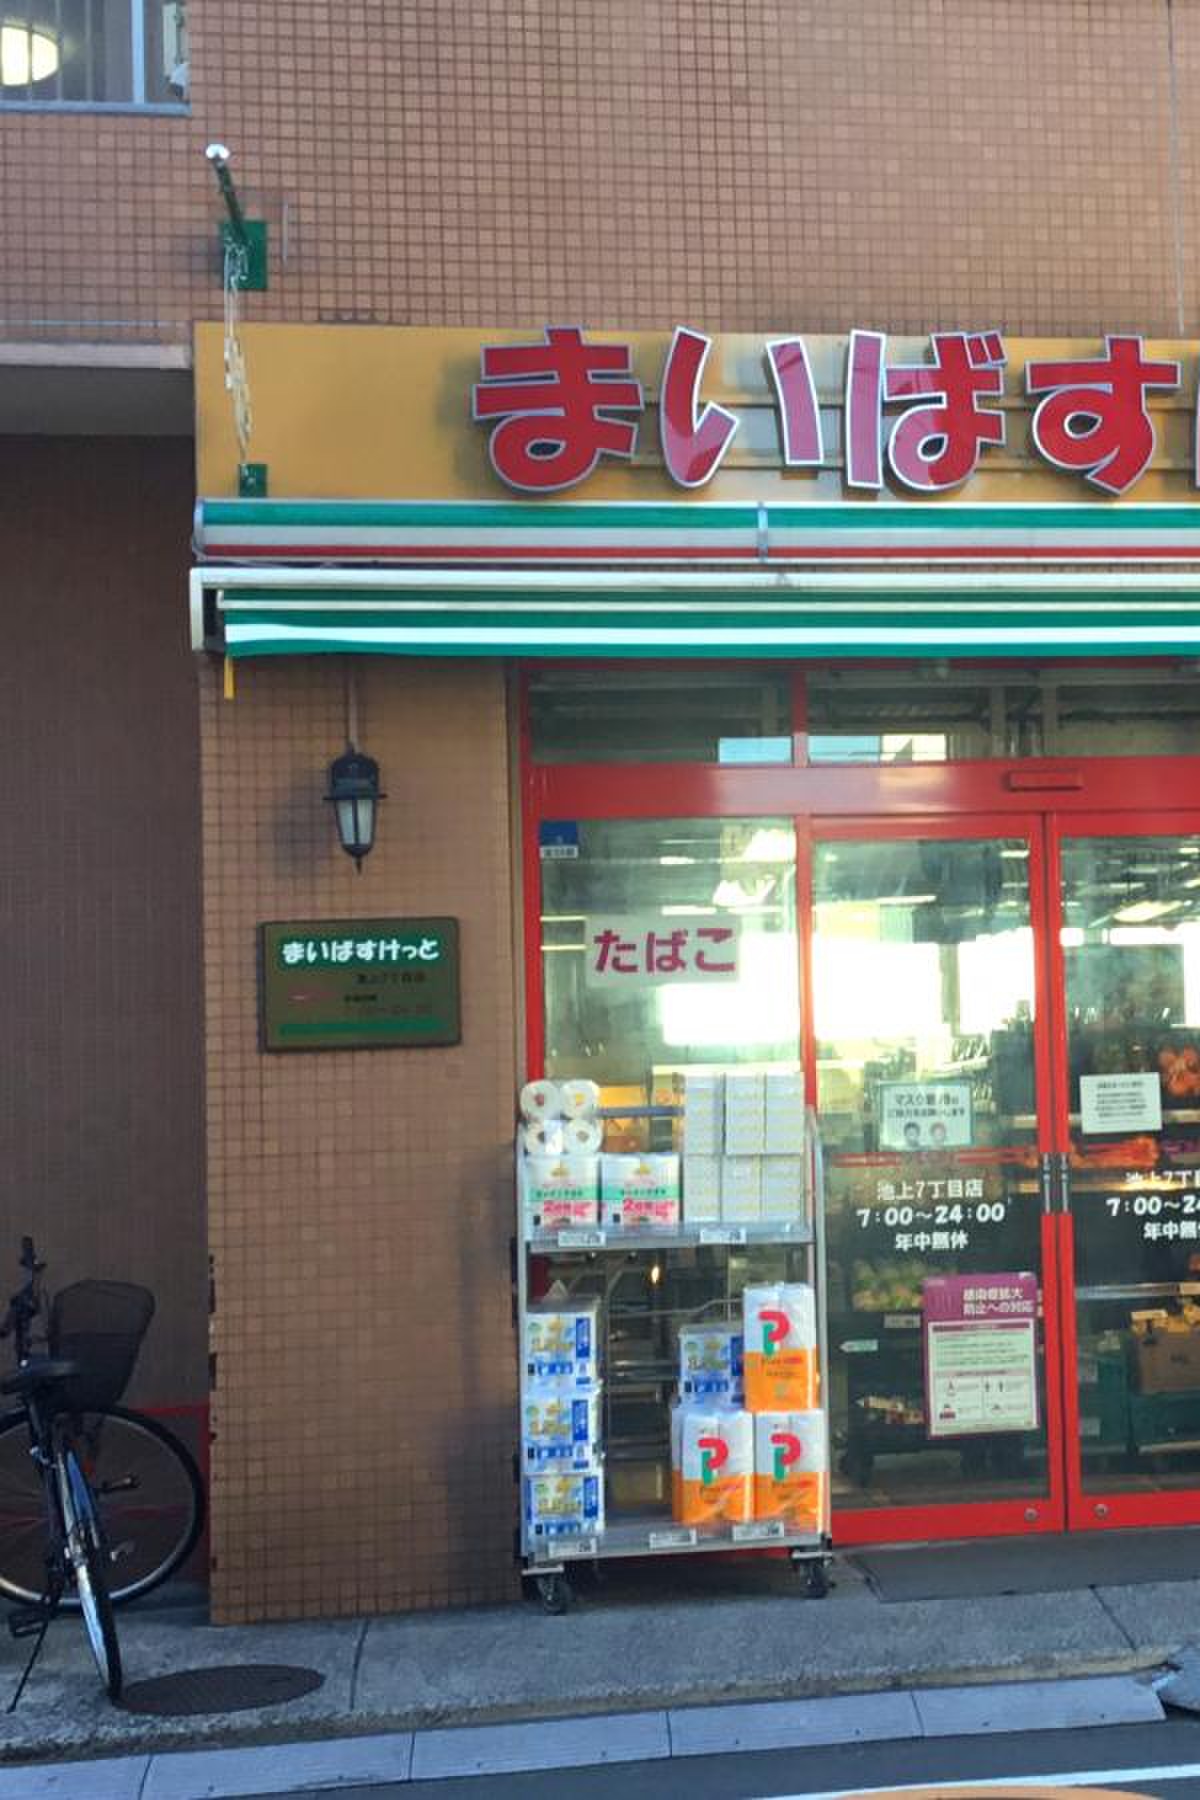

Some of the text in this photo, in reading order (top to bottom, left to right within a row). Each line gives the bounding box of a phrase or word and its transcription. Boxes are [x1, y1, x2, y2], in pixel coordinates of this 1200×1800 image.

[281, 938, 440, 965] まいばすけっと
[593, 928, 737, 974] たばこ
[876, 1178, 984, 1201] 池上7丁目店
[894, 1229, 969, 1252] 年中無休
